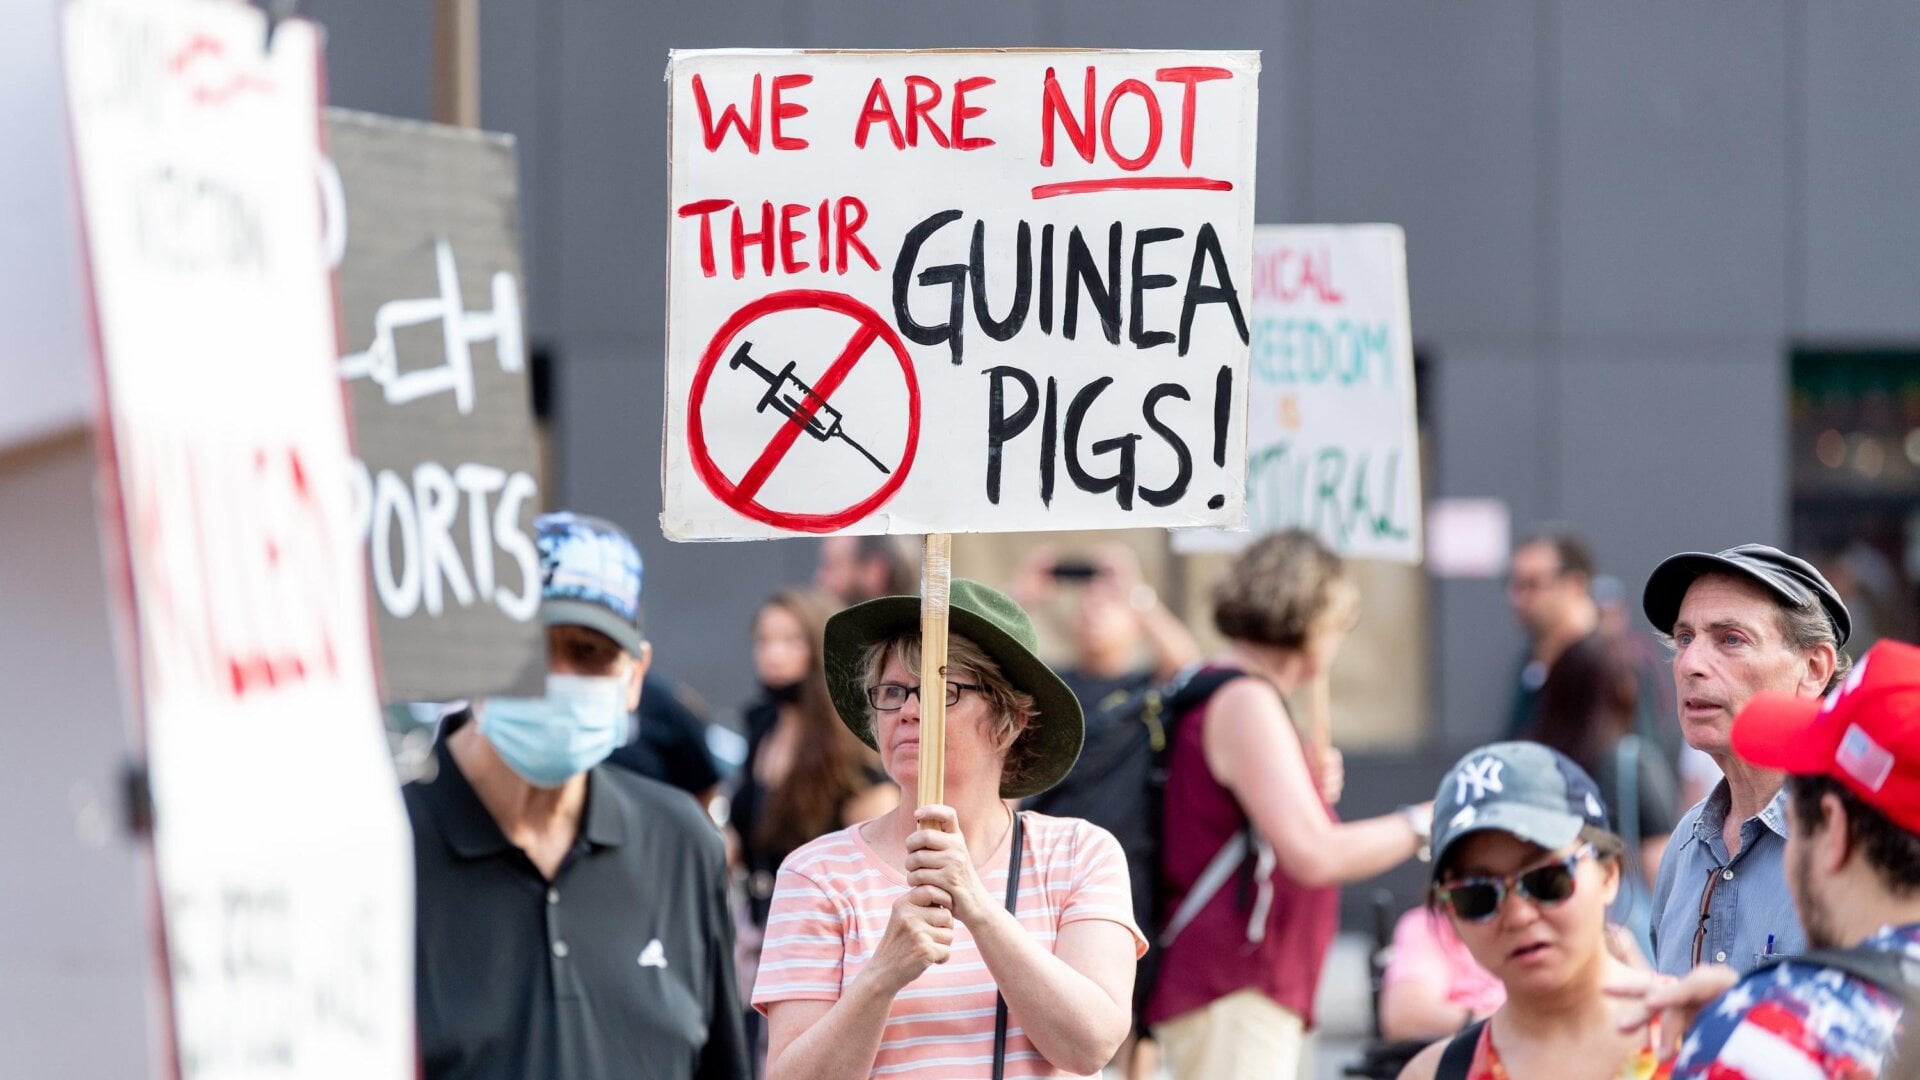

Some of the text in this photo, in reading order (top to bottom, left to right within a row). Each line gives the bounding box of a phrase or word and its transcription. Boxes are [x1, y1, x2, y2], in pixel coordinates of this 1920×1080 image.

[691, 64, 1233, 171] WE ARE NOT
[676, 196, 1250, 366] THEIR GUINEA
[981, 365, 1233, 512] PIGS!
[1456, 757, 1504, 804] NY
